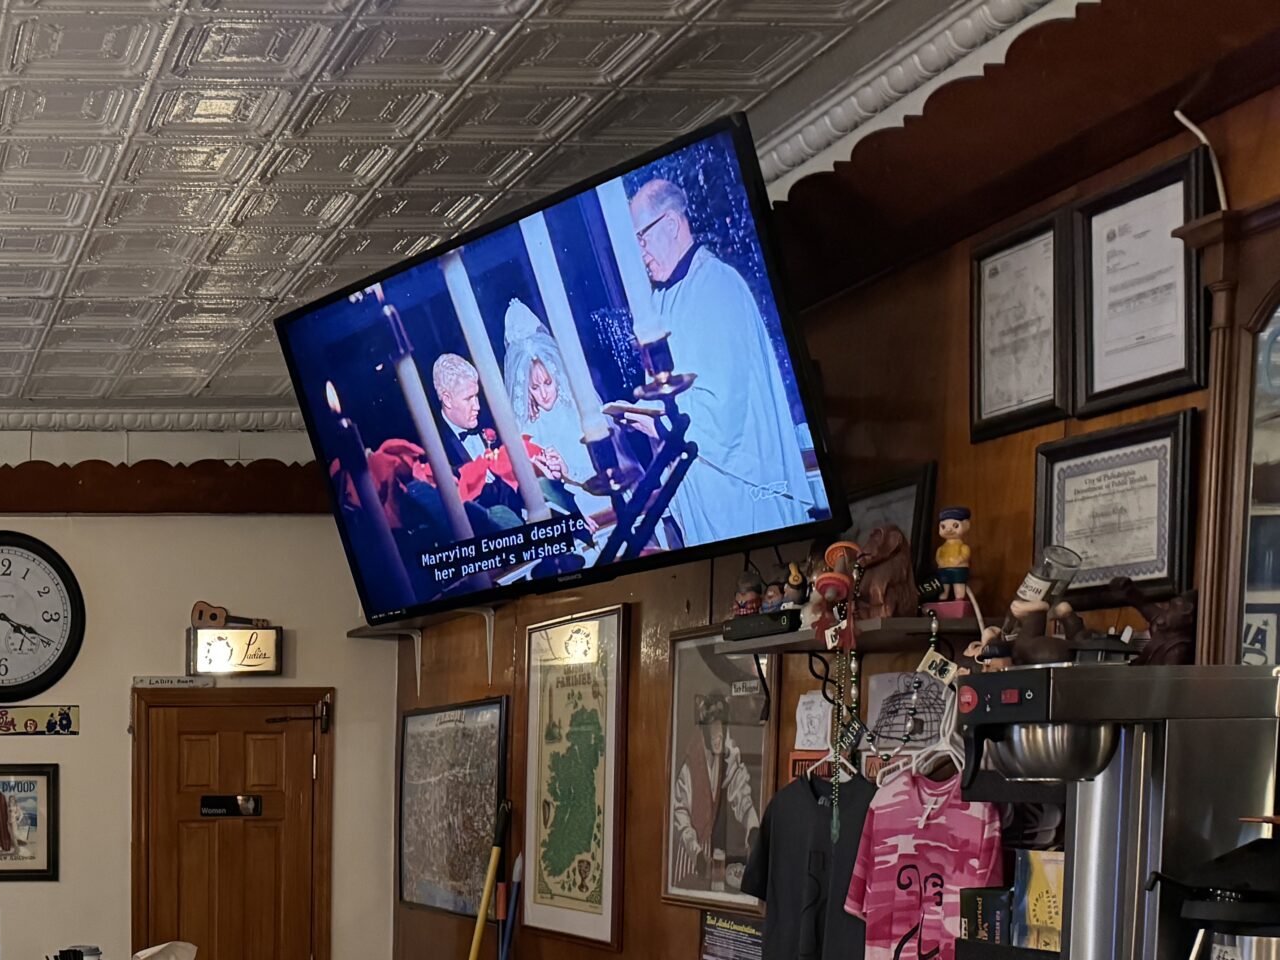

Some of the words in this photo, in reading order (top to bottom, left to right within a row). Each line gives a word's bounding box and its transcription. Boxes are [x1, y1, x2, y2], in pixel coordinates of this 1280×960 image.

[421, 543, 476, 568] Marrying
[481, 533, 525, 553] Evonna
[530, 518, 585, 541] despite
[21, 567, 30, 580] 1
[434, 566, 456, 582] her
[461, 553, 517, 577] parent's
[36, 586, 51, 598] 2
[41, 610, 61, 623] 3
[234, 631, 271, 667] Ladies
[839, 720, 861, 750] IRISH
[201, 806, 227, 815] Women
